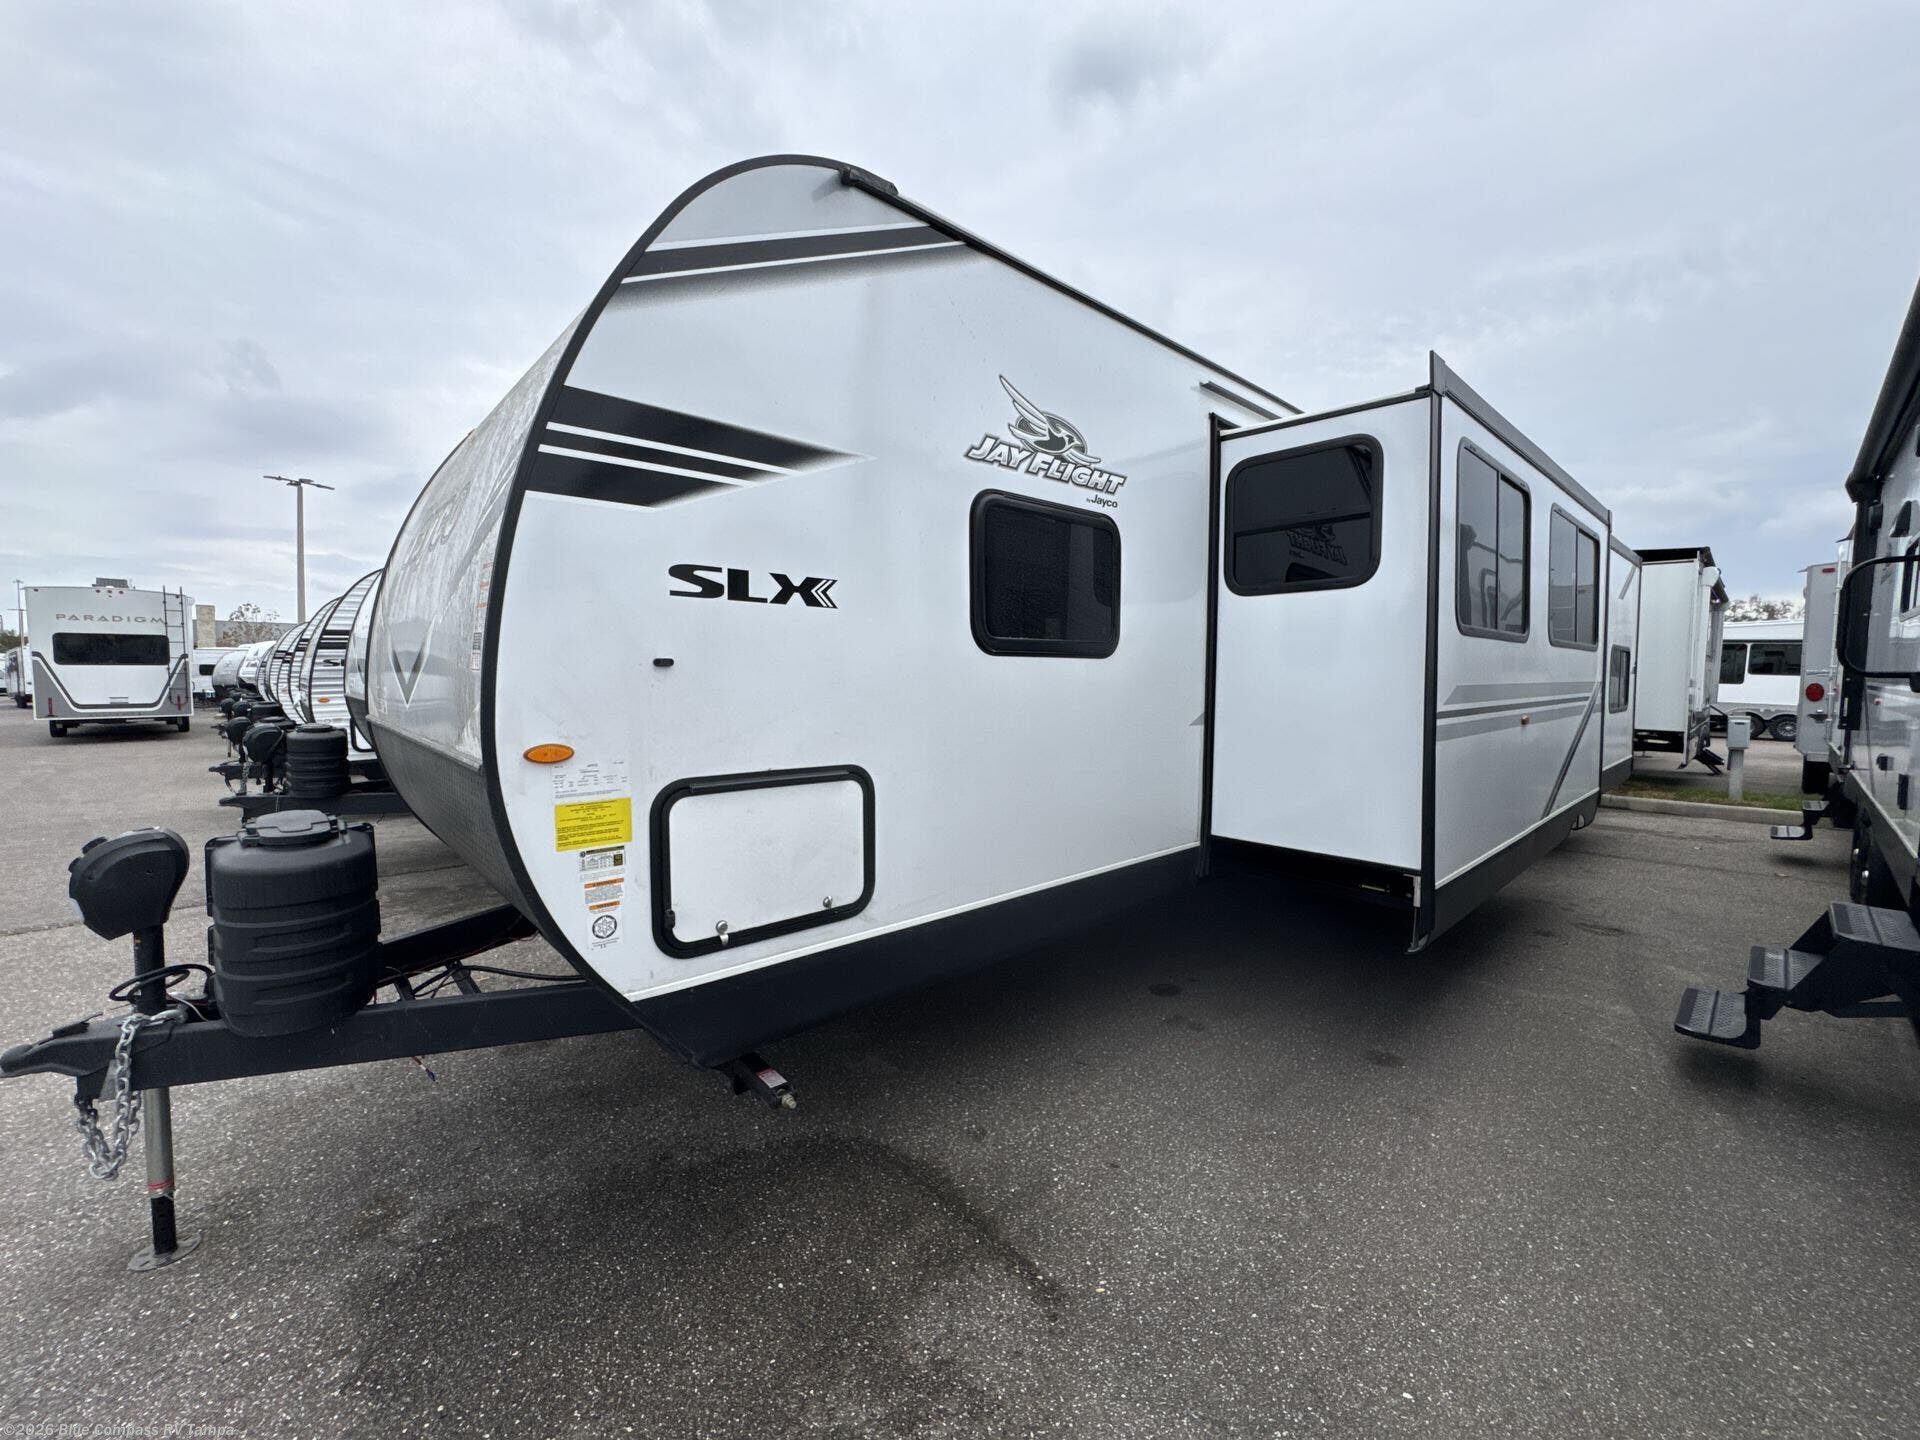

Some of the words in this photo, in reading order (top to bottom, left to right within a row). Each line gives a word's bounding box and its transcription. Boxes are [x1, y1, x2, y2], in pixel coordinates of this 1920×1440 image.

[965, 433, 1032, 471] JAY
[1025, 452, 1127, 494] FLIGHT
[1091, 494, 1118, 508] Jayco
[668, 563, 839, 610] SLX
[55, 613, 165, 625] PARADIGM
